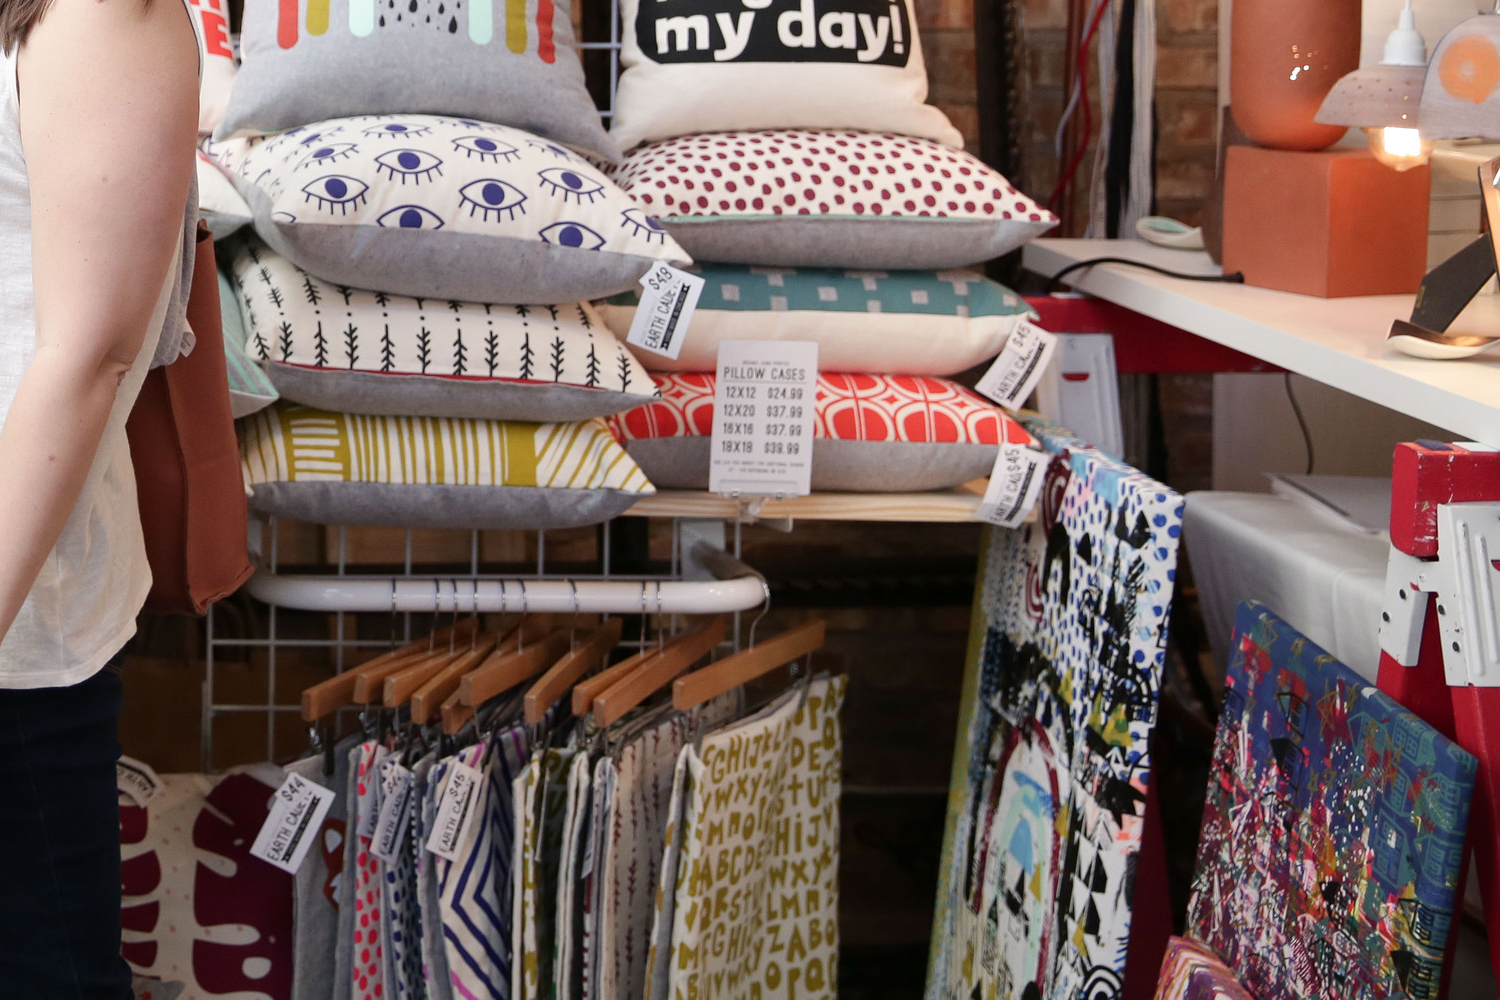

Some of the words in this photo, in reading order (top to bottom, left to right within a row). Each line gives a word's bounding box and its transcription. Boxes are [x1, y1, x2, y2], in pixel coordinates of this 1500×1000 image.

[655, 10, 756, 62] my
[648, 266, 673, 290] $48
[644, 316, 666, 349] EARTH
[656, 280, 681, 315] CADE
[723, 366, 765, 380] PILLOW
[770, 367, 806, 381] CASES
[726, 386, 757, 399] 12X12
[767, 387, 803, 400] $24.99
[723, 404, 756, 417] 12X20
[766, 405, 803, 418] $37.99
[765, 424, 802, 437] $37.99
[764, 442, 800, 455] $39.99
[281, 776, 306, 802] $44
[266, 827, 293, 862] EARTH
[285, 790, 313, 826] CADE
[380, 820, 395, 856] EARTH
[440, 818, 457, 853] EARTH
